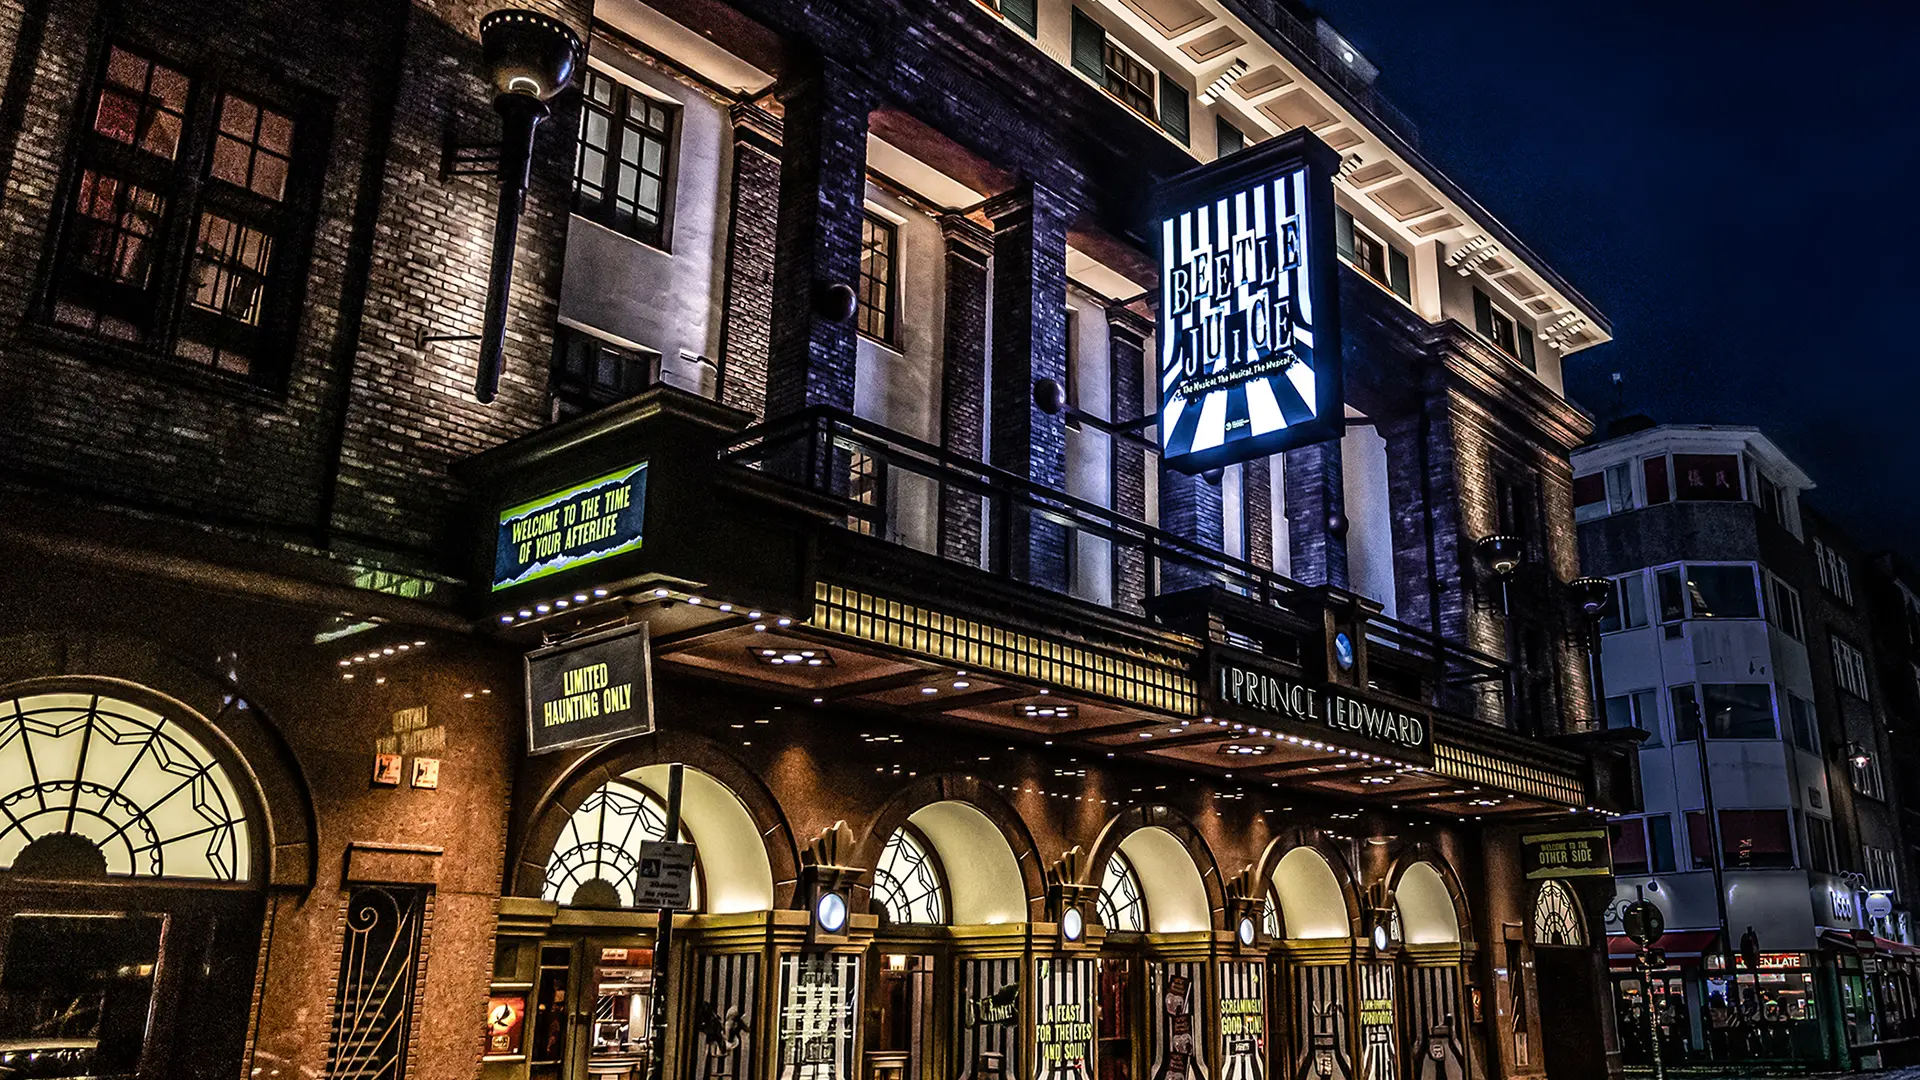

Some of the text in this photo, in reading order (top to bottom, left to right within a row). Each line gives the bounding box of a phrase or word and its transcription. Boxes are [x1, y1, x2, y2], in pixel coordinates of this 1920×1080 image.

[1172, 217, 1300, 315] BEETLE
[1185, 296, 1293, 377] JUICE
[1183, 385, 1193, 394] The
[1218, 374, 1229, 384] The
[1254, 363, 1266, 373] The
[512, 485, 632, 544] WELCOME TO THE TIME
[518, 513, 619, 565] OF YOUR AFTERLIFE
[563, 662, 609, 697] LIMITED
[543, 683, 632, 727] HAUNTING ONLY
[1222, 667, 1423, 746] PRINCE EDWARD
[1539, 849, 1593, 864] OTHER SIDE
[1540, 841, 1589, 852] WELCOME TO THE
[1776, 956, 1800, 967] LATE
[1057, 1004, 1081, 1022] FEAST
[1220, 999, 1262, 1014] SCREAMINGLY
[1036, 1023, 1092, 1042] FOR THE EYES
[1221, 1017, 1242, 1035] GOOD
[1043, 1043, 1061, 1060] AND
